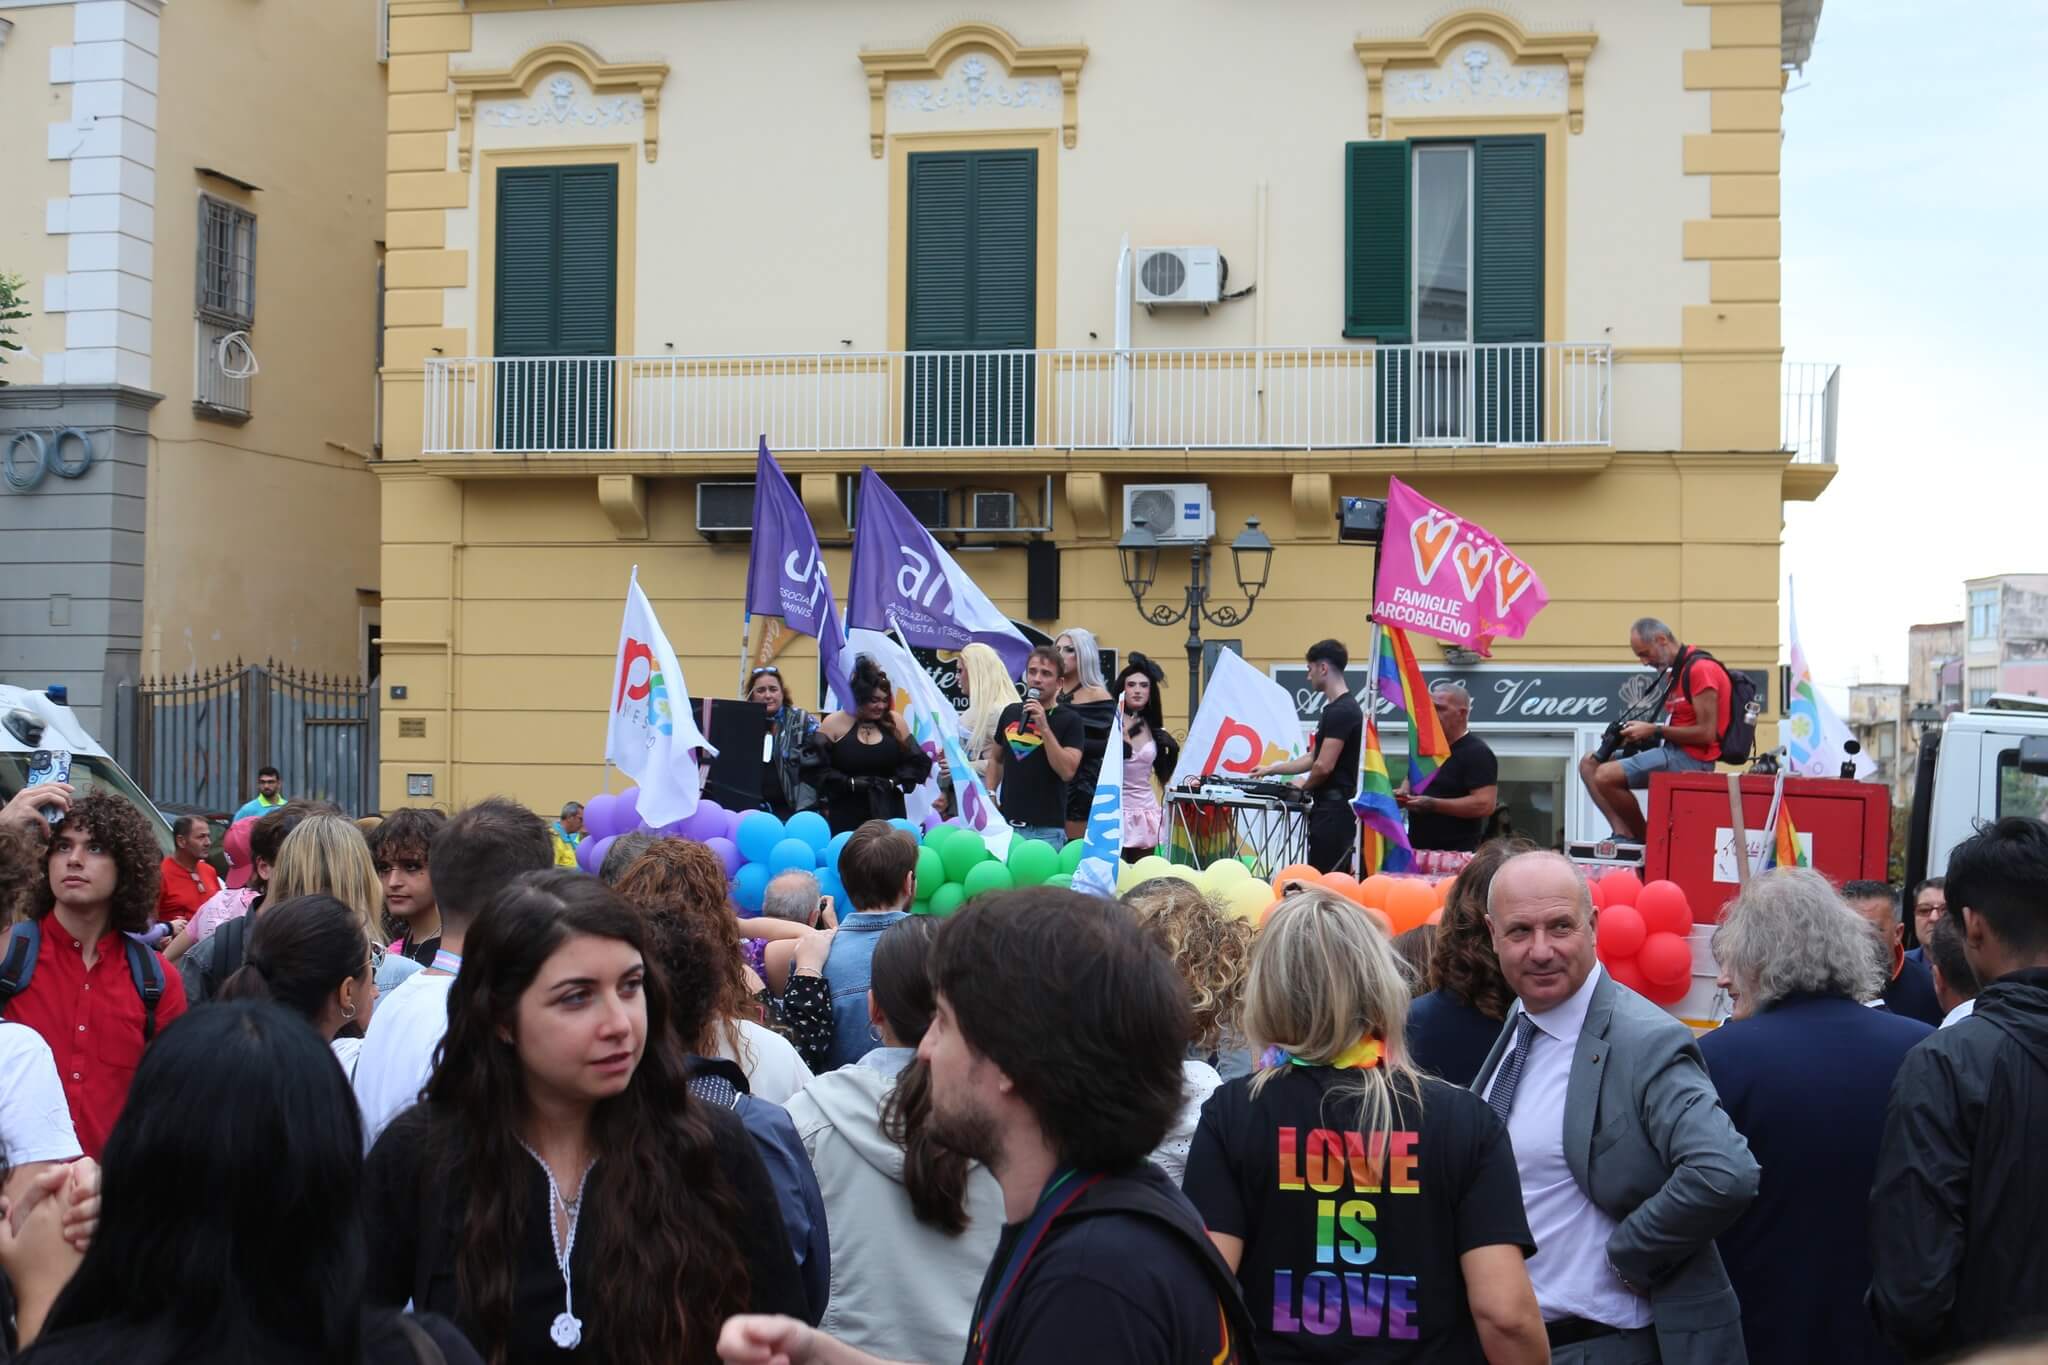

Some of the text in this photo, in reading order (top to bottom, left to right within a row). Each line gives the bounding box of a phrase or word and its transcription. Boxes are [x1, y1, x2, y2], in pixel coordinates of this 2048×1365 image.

[1375, 601, 1471, 638] ARCOBALENO
[1393, 586, 1463, 617] FAMIGLIE
[1494, 678, 1608, 716] Venere
[1278, 1126, 1420, 1194] LOVE
[1316, 1199, 1377, 1265] IS
[1272, 1269, 1419, 1340] LOVE
